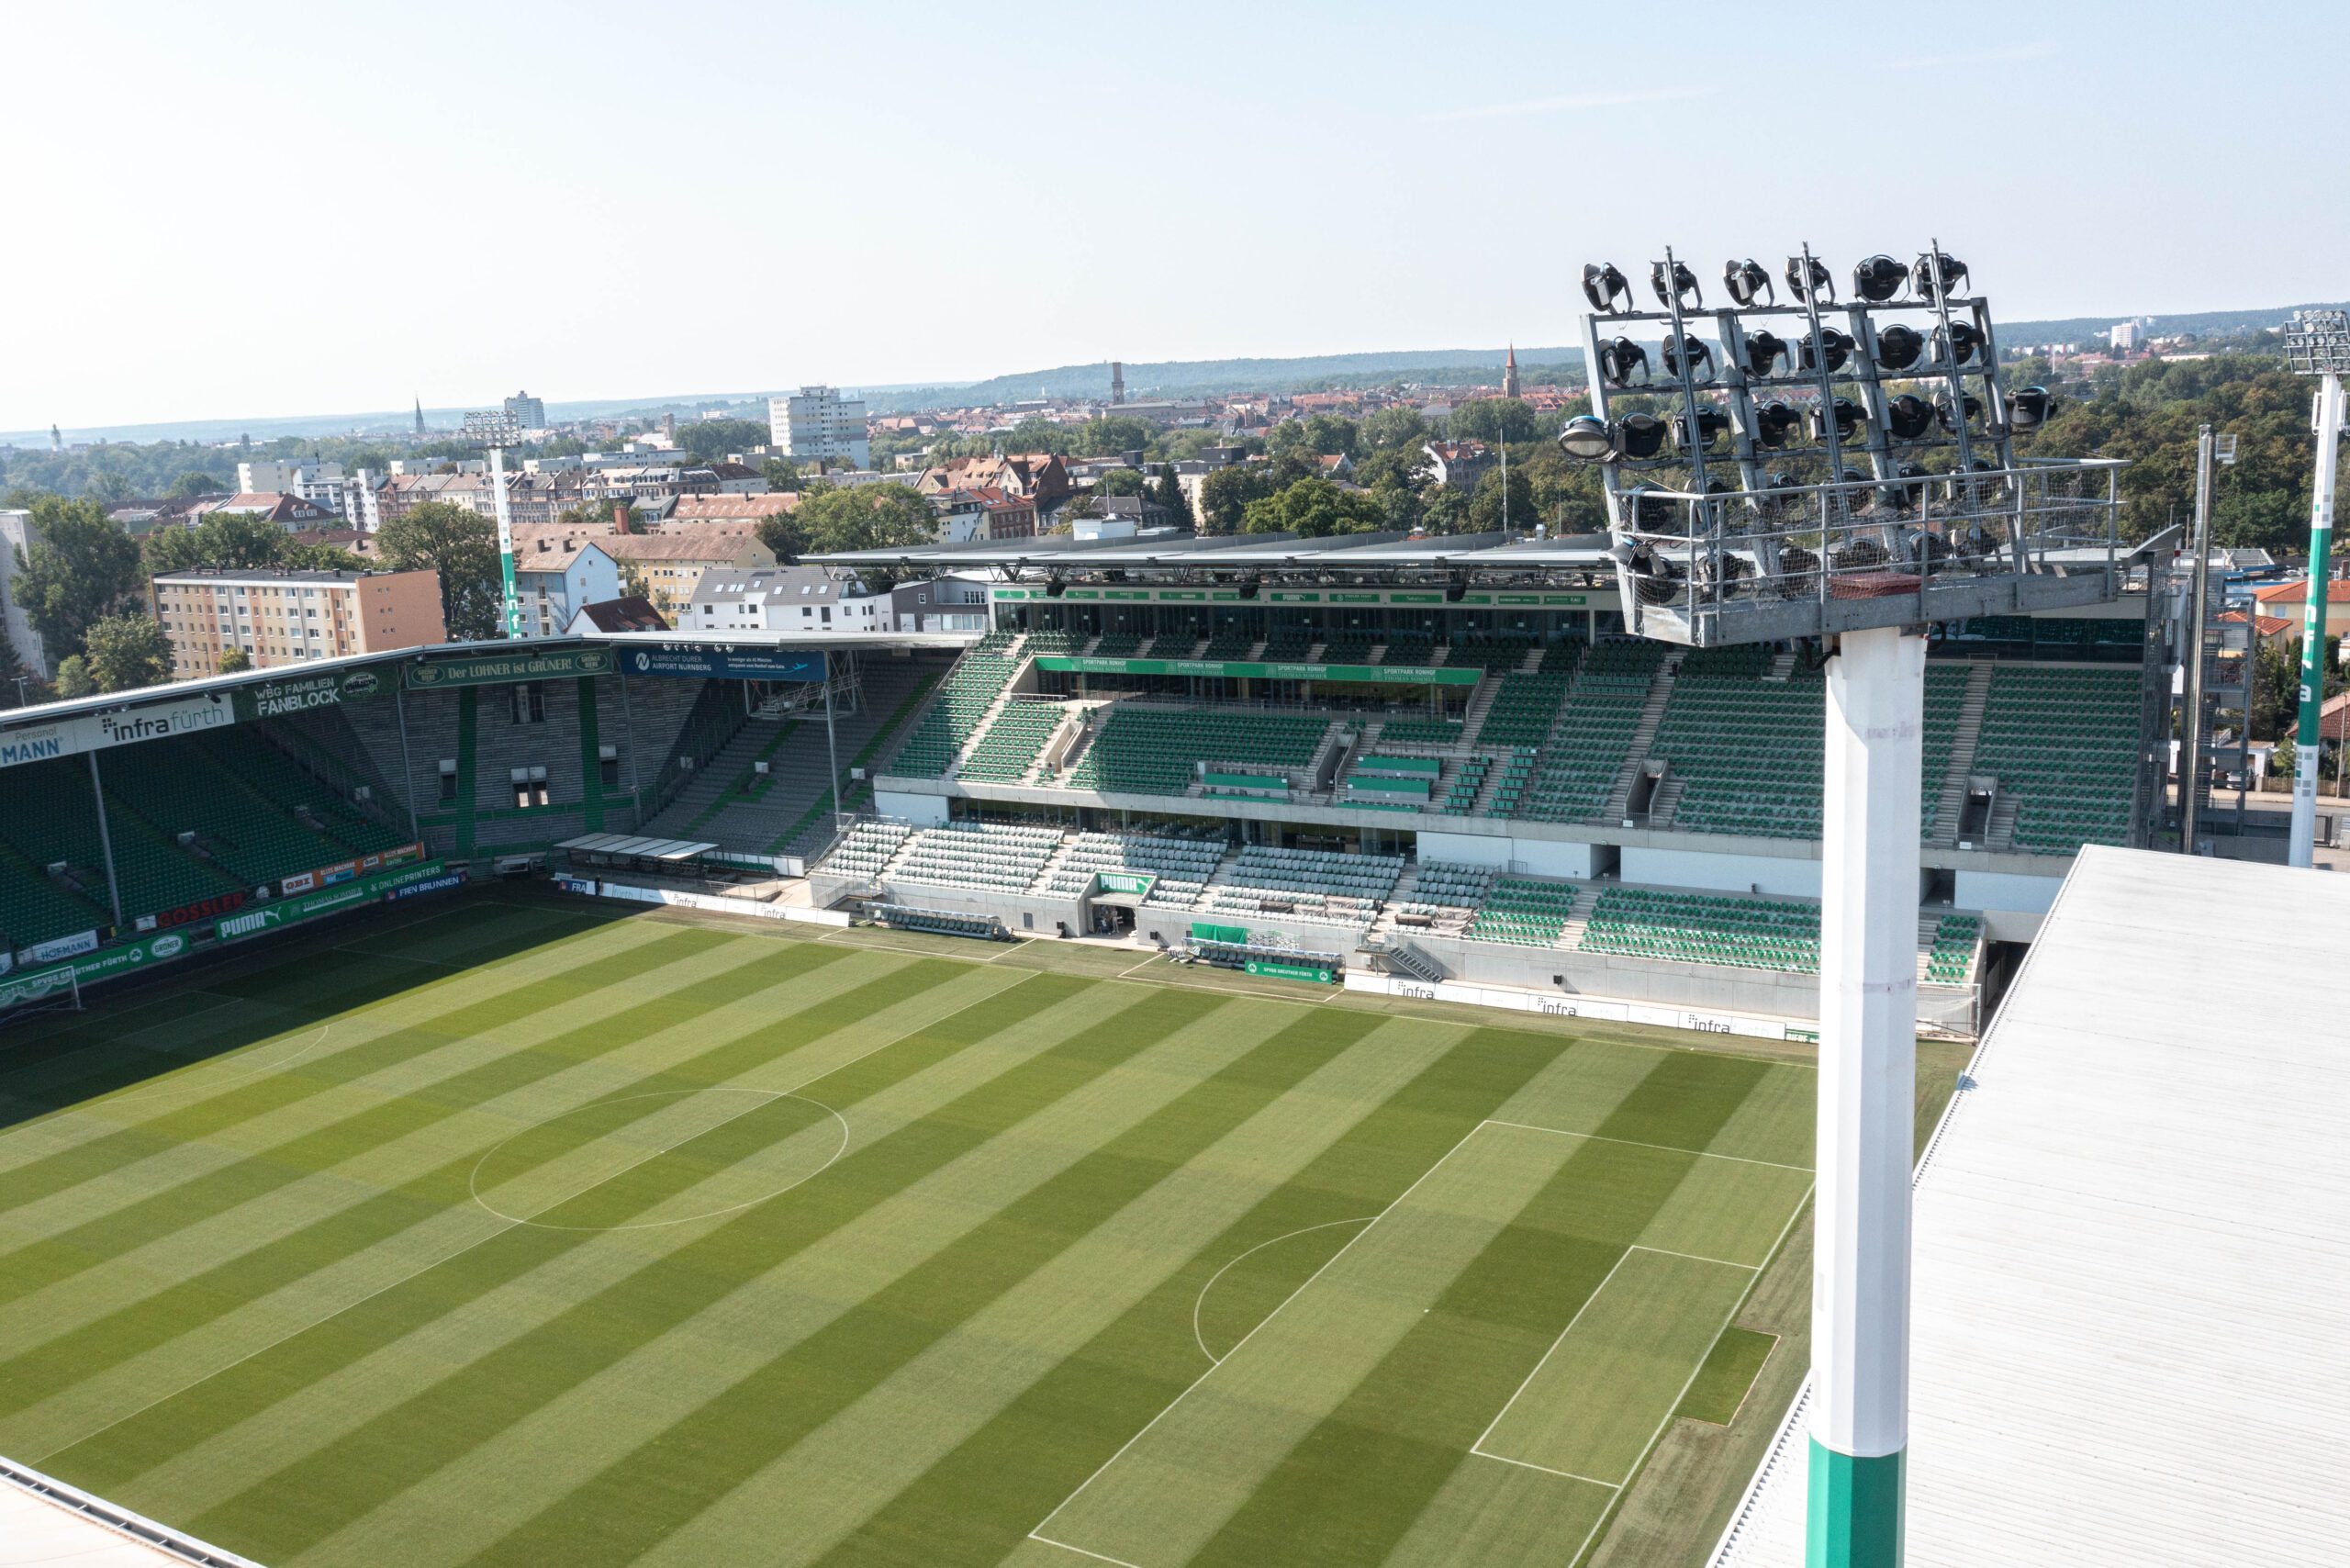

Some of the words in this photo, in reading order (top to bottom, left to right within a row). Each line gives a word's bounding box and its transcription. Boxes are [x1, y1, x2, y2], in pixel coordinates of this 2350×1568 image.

[448, 667, 467, 679] Der
[469, 663, 509, 678] LOHNER
[513, 662, 525, 675] ist
[528, 657, 572, 673] GRÜNER!
[255, 687, 282, 700] WBG
[285, 677, 334, 695] FAMILIEN
[258, 688, 341, 716] FANBLOCK
[113, 717, 170, 742] infra
[171, 705, 225, 731] fürth
[15, 726, 57, 742] Personal
[285, 878, 310, 890] OBI
[379, 866, 441, 889] ONLINEPRINTERS
[420, 877, 459, 892] BRUNNEN
[1101, 874, 1138, 890] PUMA
[676, 897, 698, 908] infra
[764, 908, 786, 919] infra
[219, 912, 265, 938] PUMA
[41, 939, 91, 960] HOFMANN
[102, 955, 128, 967] FÜRTH
[1403, 987, 1434, 1000] infra
[1542, 1002, 1576, 1016] infra
[1694, 1019, 1730, 1034] infra
